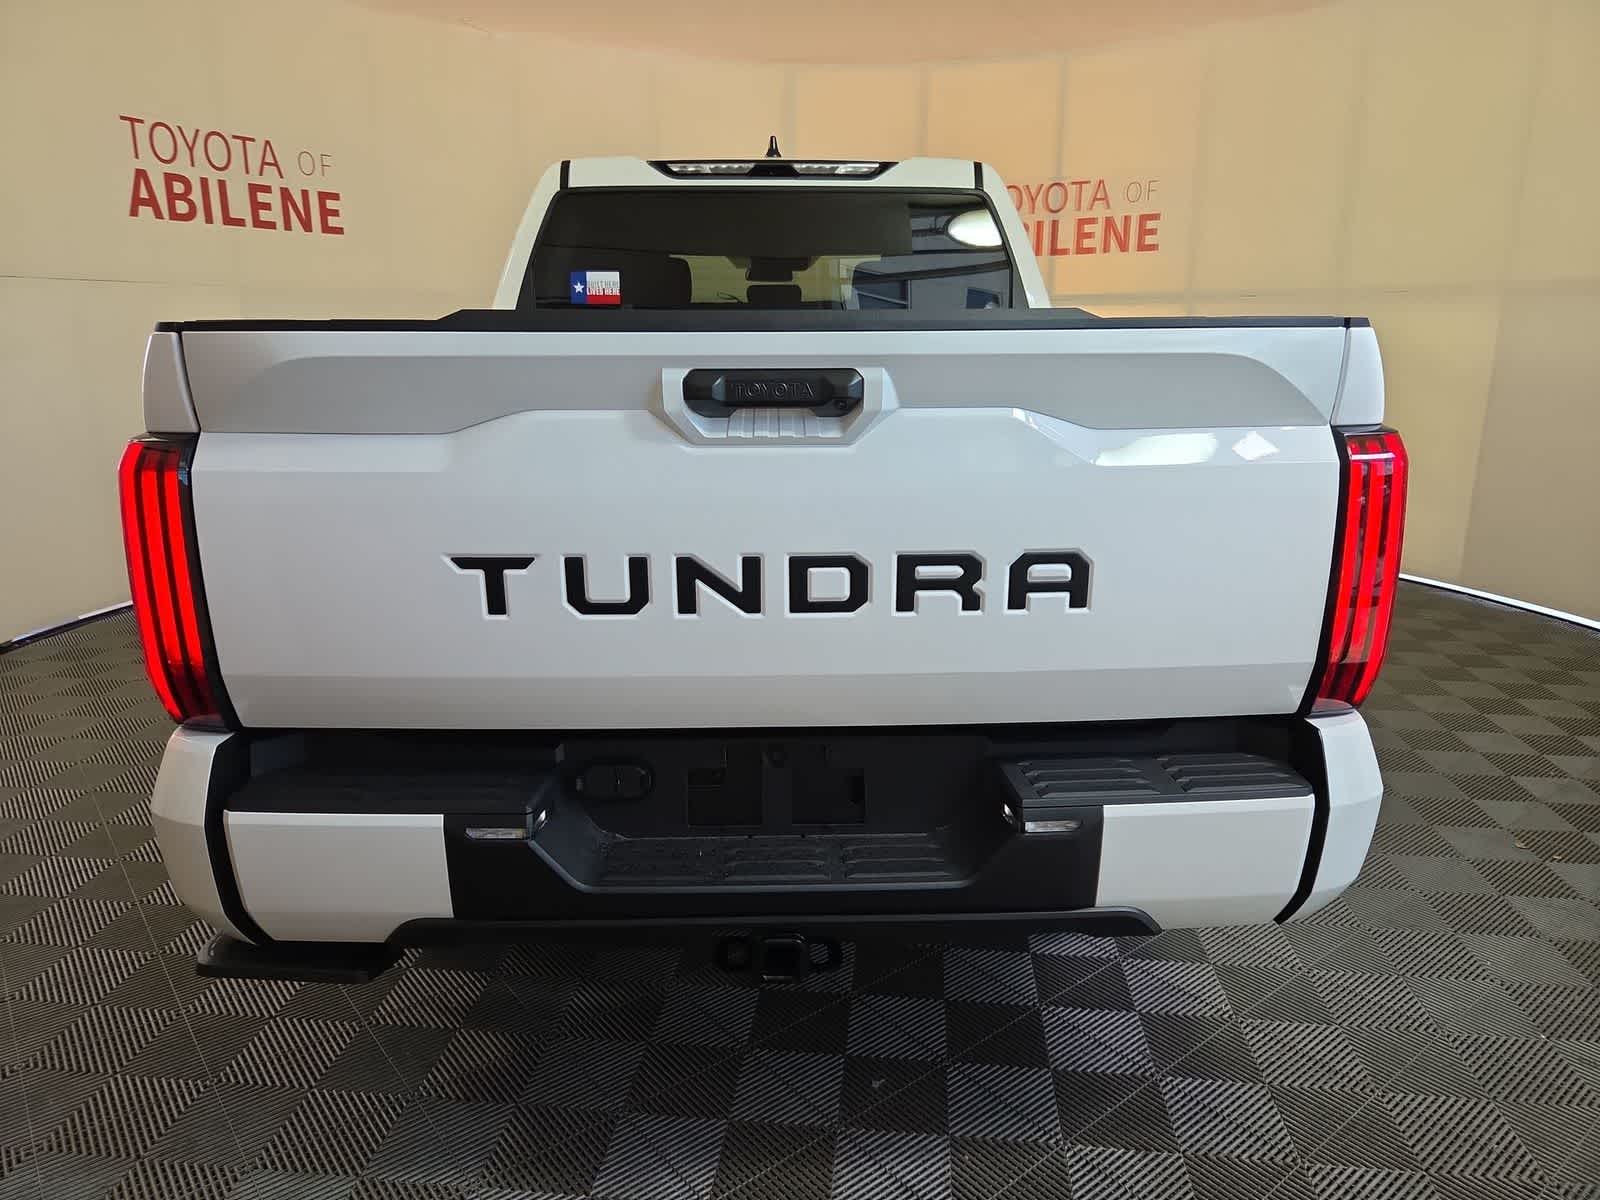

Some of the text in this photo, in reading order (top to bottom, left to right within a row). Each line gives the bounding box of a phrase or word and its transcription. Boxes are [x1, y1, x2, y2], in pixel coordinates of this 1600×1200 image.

[119, 114, 332, 179] TOYOTA OF
[128, 167, 345, 235] ABILENE
[1005, 179, 1160, 214] OYOTA OF
[1022, 212, 1161, 257] ILENE
[604, 288, 621, 296] HERE
[734, 383, 816, 401] TOYOTA
[443, 549, 1093, 619] TUNDRA
